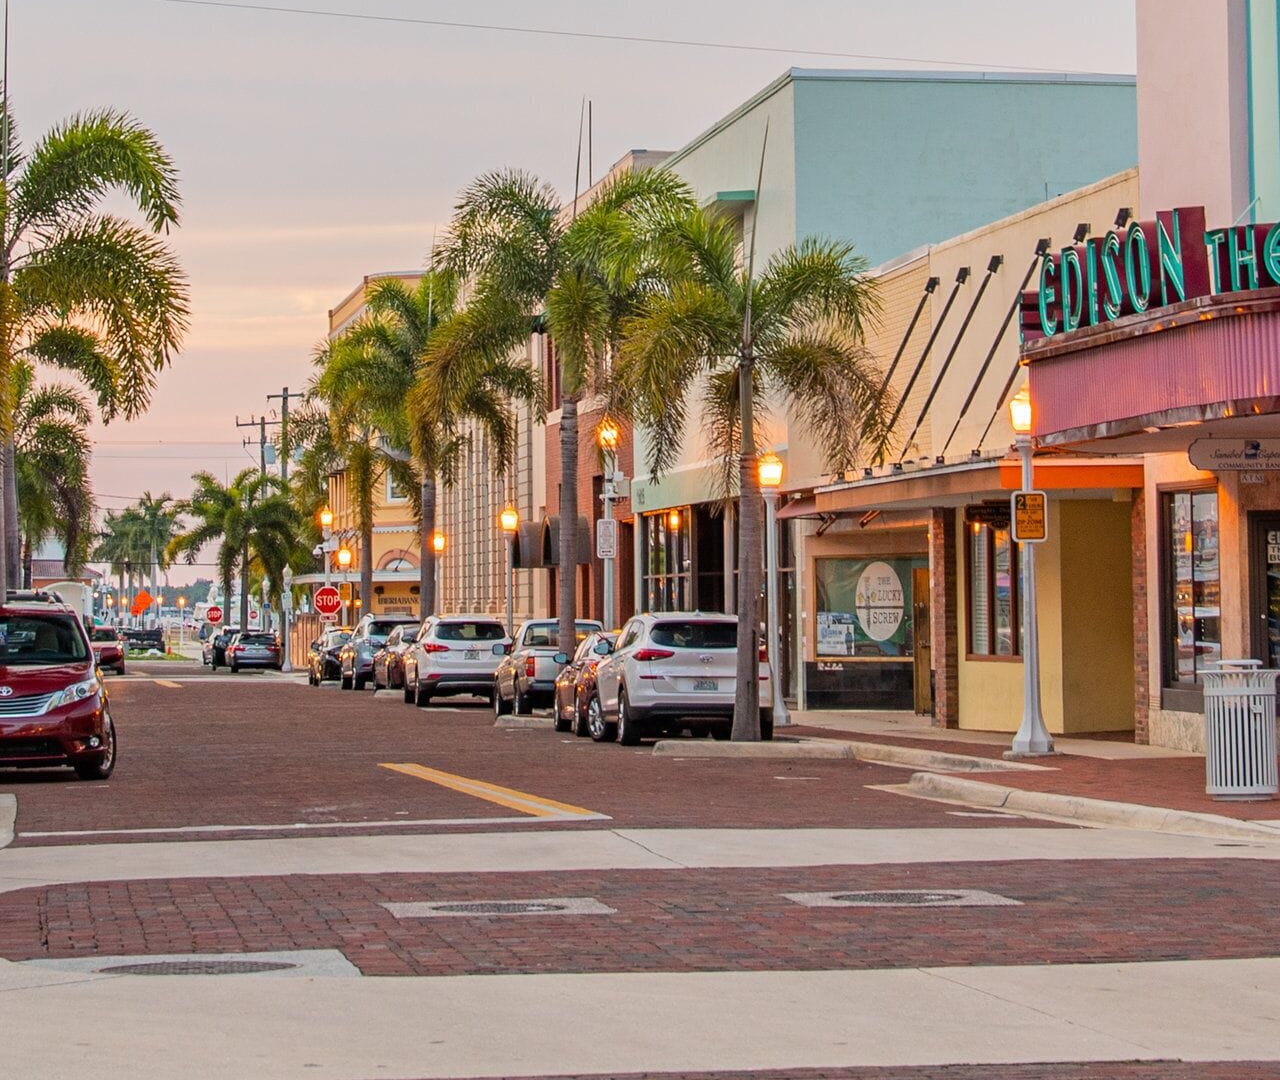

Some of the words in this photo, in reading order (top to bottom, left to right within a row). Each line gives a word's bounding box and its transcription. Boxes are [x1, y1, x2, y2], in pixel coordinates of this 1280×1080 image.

[1039, 206, 1186, 337] EDISON
[1017, 496, 1024, 509] 2
[877, 576, 891, 586] THE
[316, 595, 339, 606] STOP
[877, 589, 902, 601] LUCKY
[207, 610, 221, 619] STOP
[872, 612, 899, 624] SCREW
